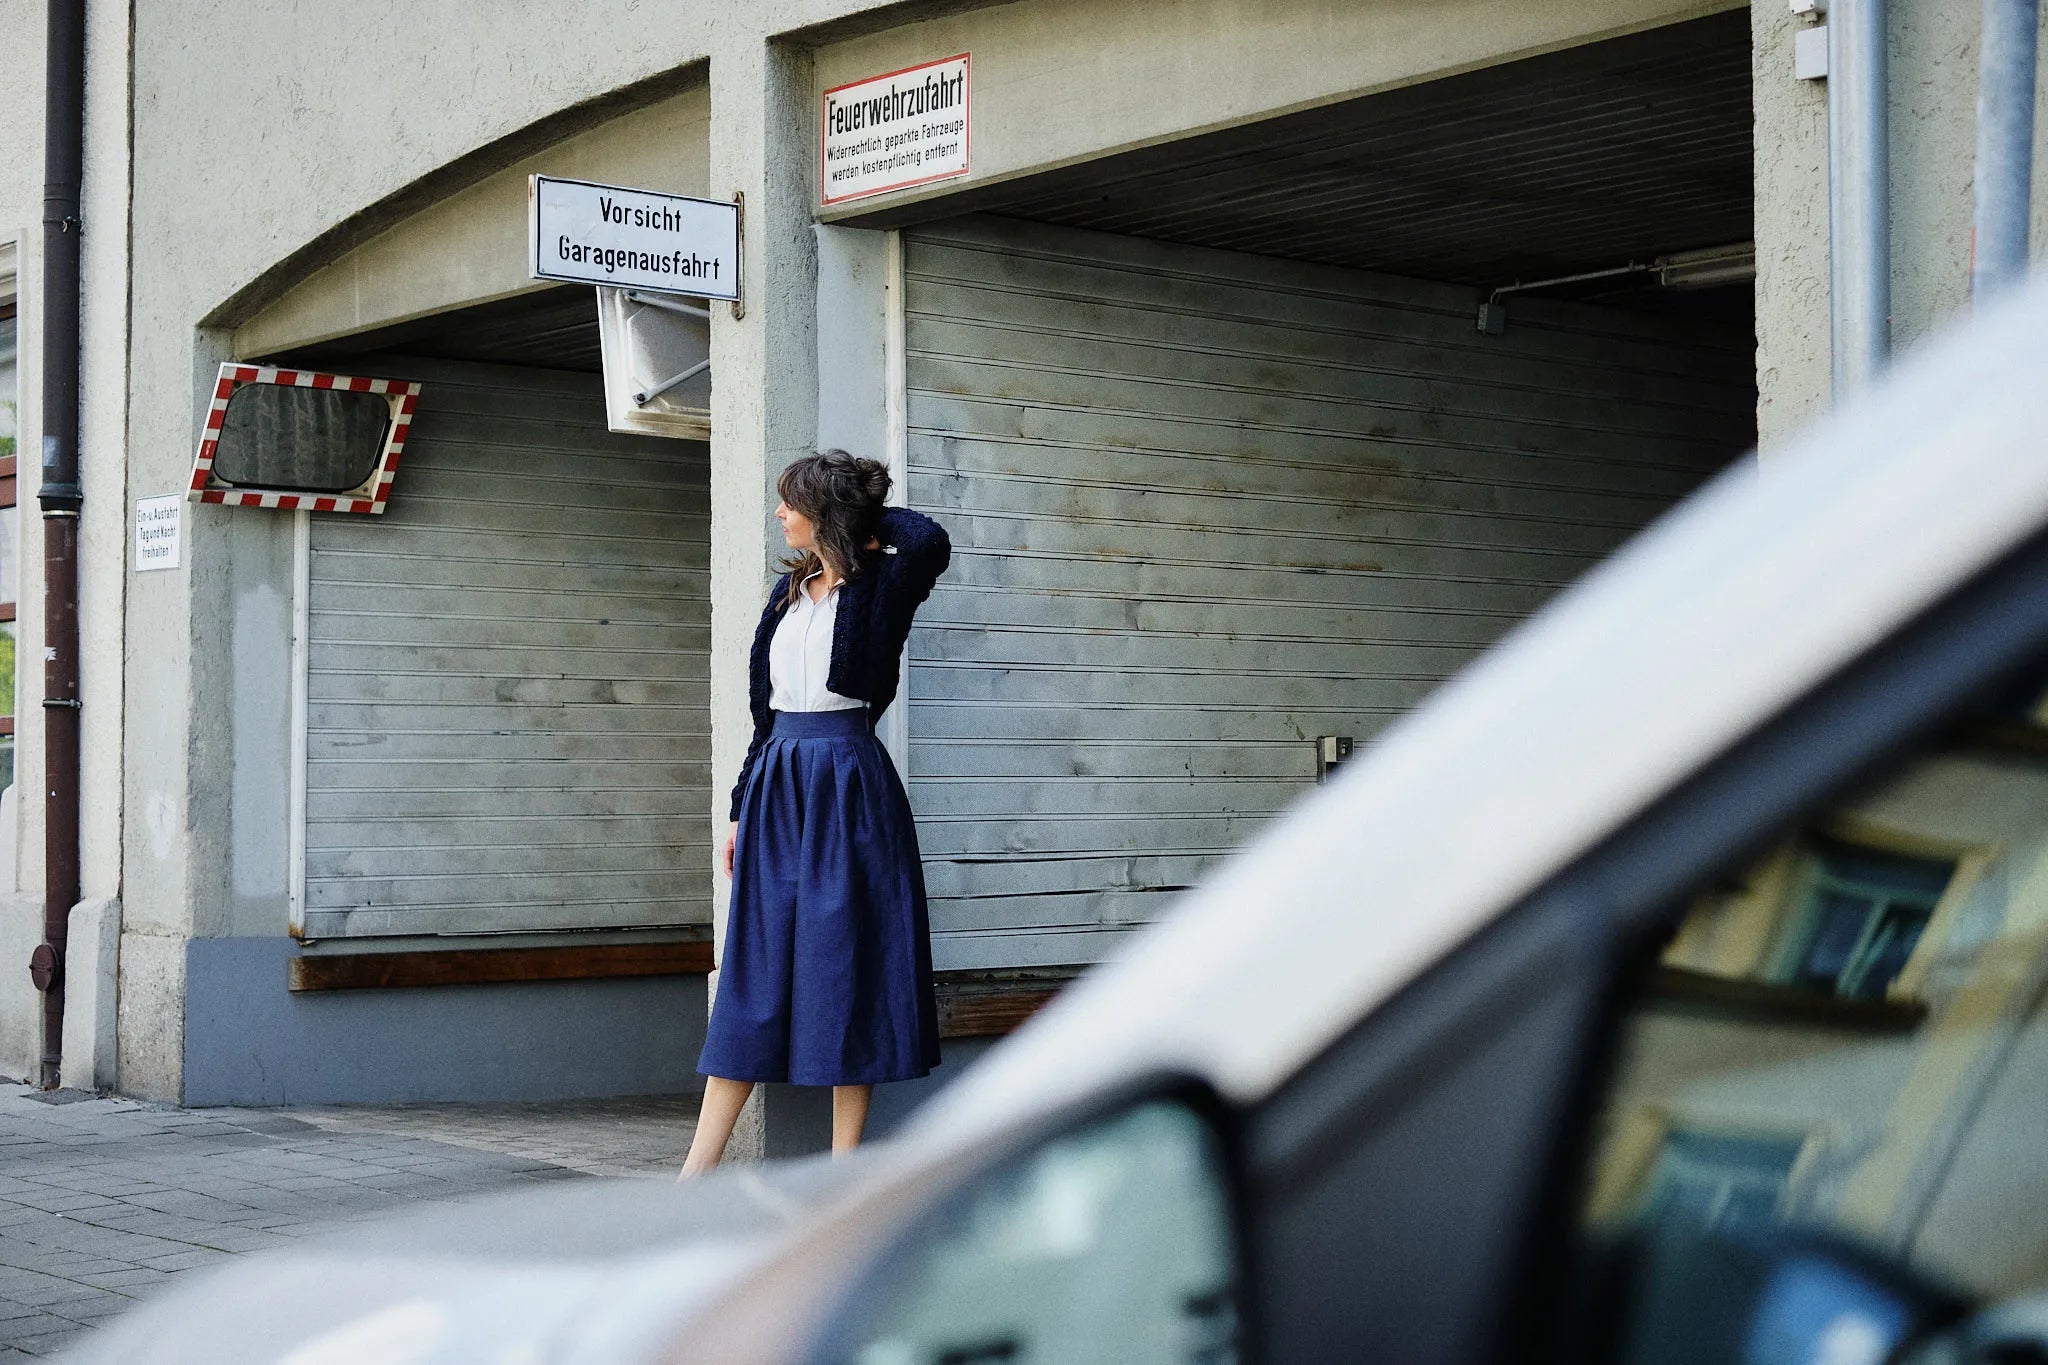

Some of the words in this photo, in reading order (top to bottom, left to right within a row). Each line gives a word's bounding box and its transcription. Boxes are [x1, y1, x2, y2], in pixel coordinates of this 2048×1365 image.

[829, 69, 964, 137] Feuerwehrzufahrt
[827, 135, 882, 162] Widerrechtlich
[884, 129, 919, 151] geparkte
[921, 119, 964, 140] Fahrzeuge
[832, 164, 860, 182] werden
[862, 149, 921, 174] kostenpflichtig
[925, 142, 958, 161] entfernt
[600, 196, 681, 232] Vorsicht
[559, 235, 719, 280] Garagenausfahrt
